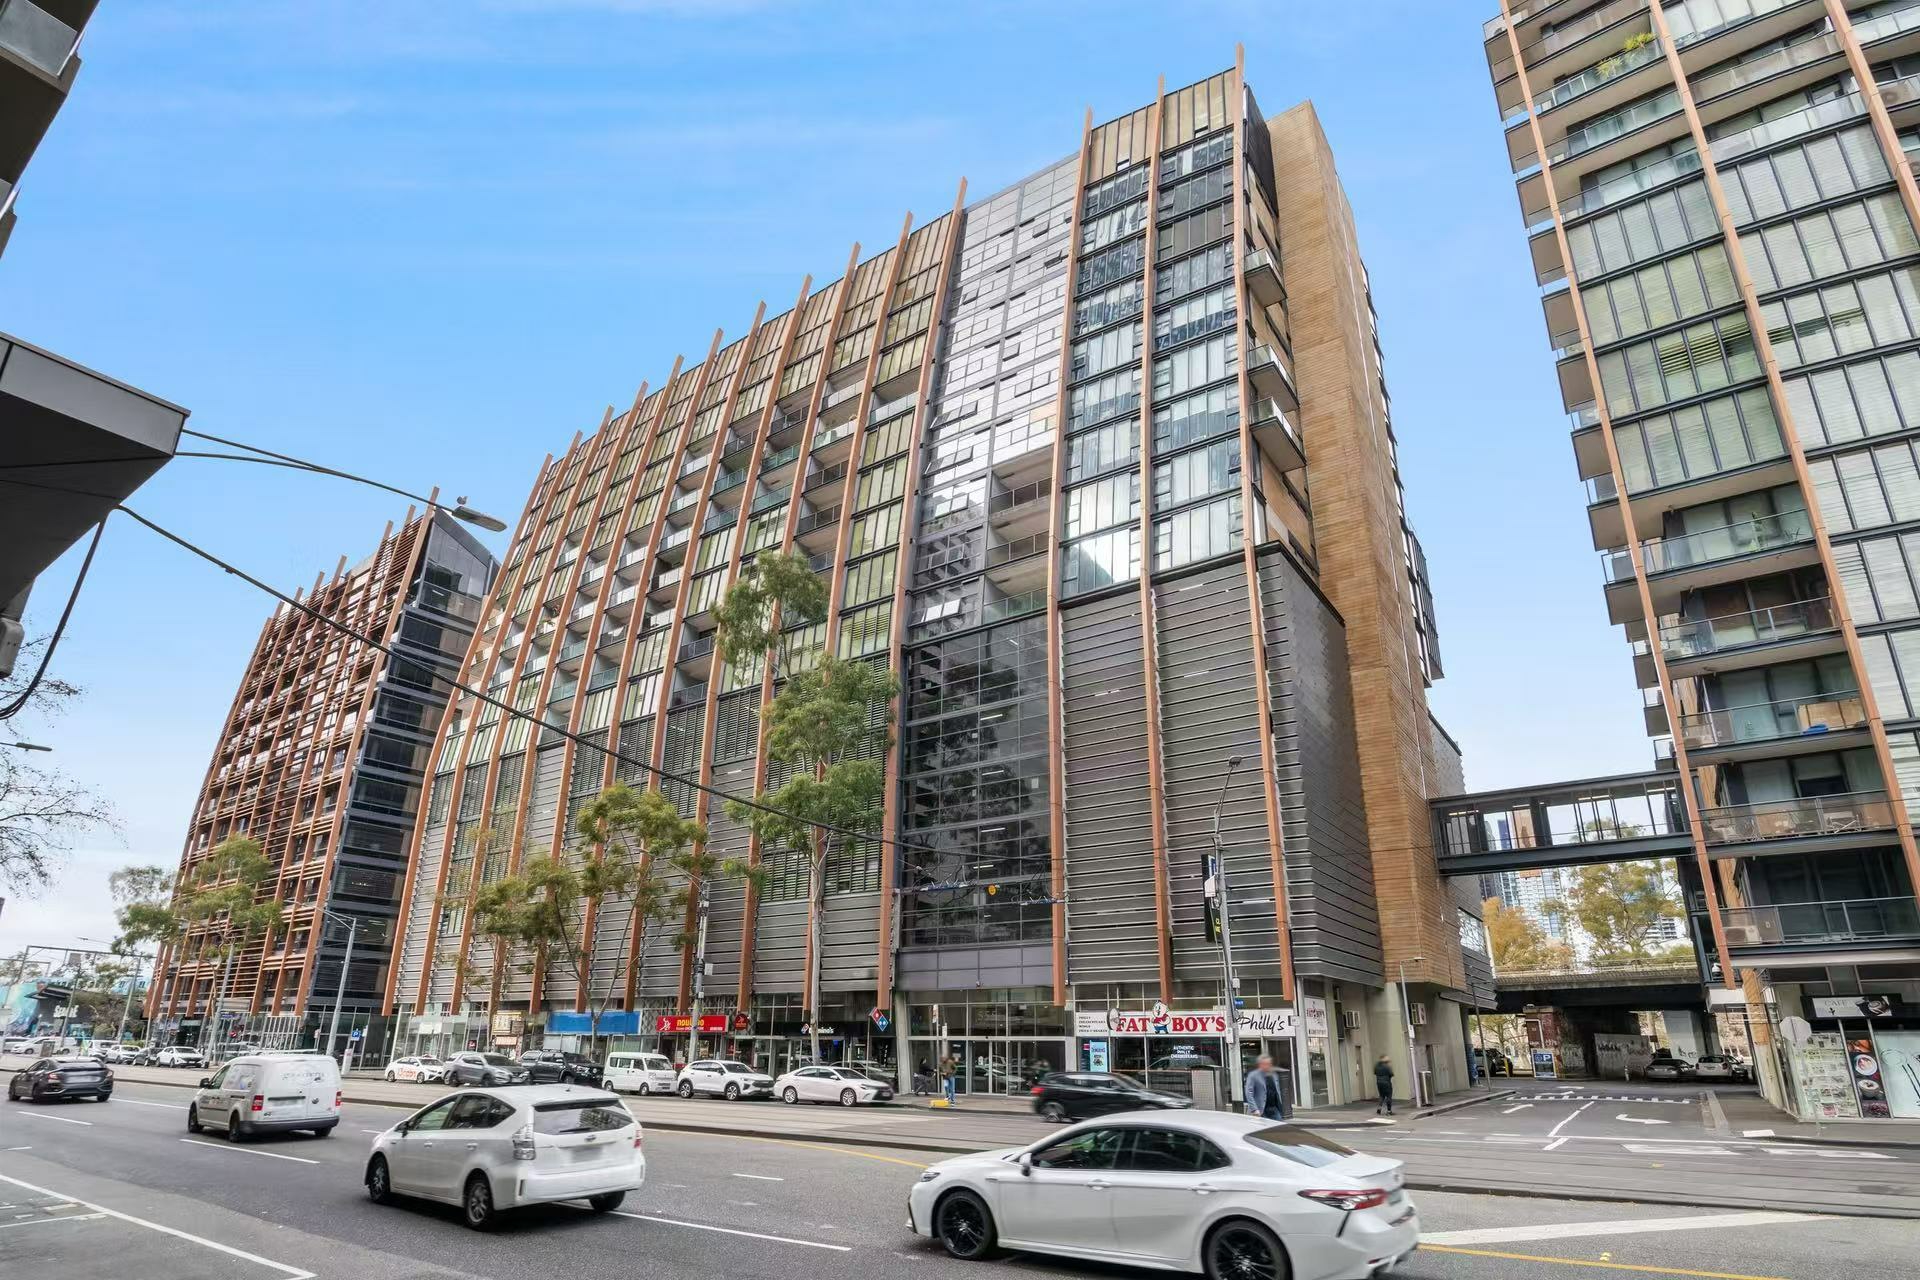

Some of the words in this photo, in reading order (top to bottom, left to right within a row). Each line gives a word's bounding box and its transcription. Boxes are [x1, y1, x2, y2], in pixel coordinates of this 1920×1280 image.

[1115, 1017, 1151, 1032] FAT
[1172, 1016, 1227, 1032] BOY'S
[1236, 1014, 1286, 1034] Philly's
